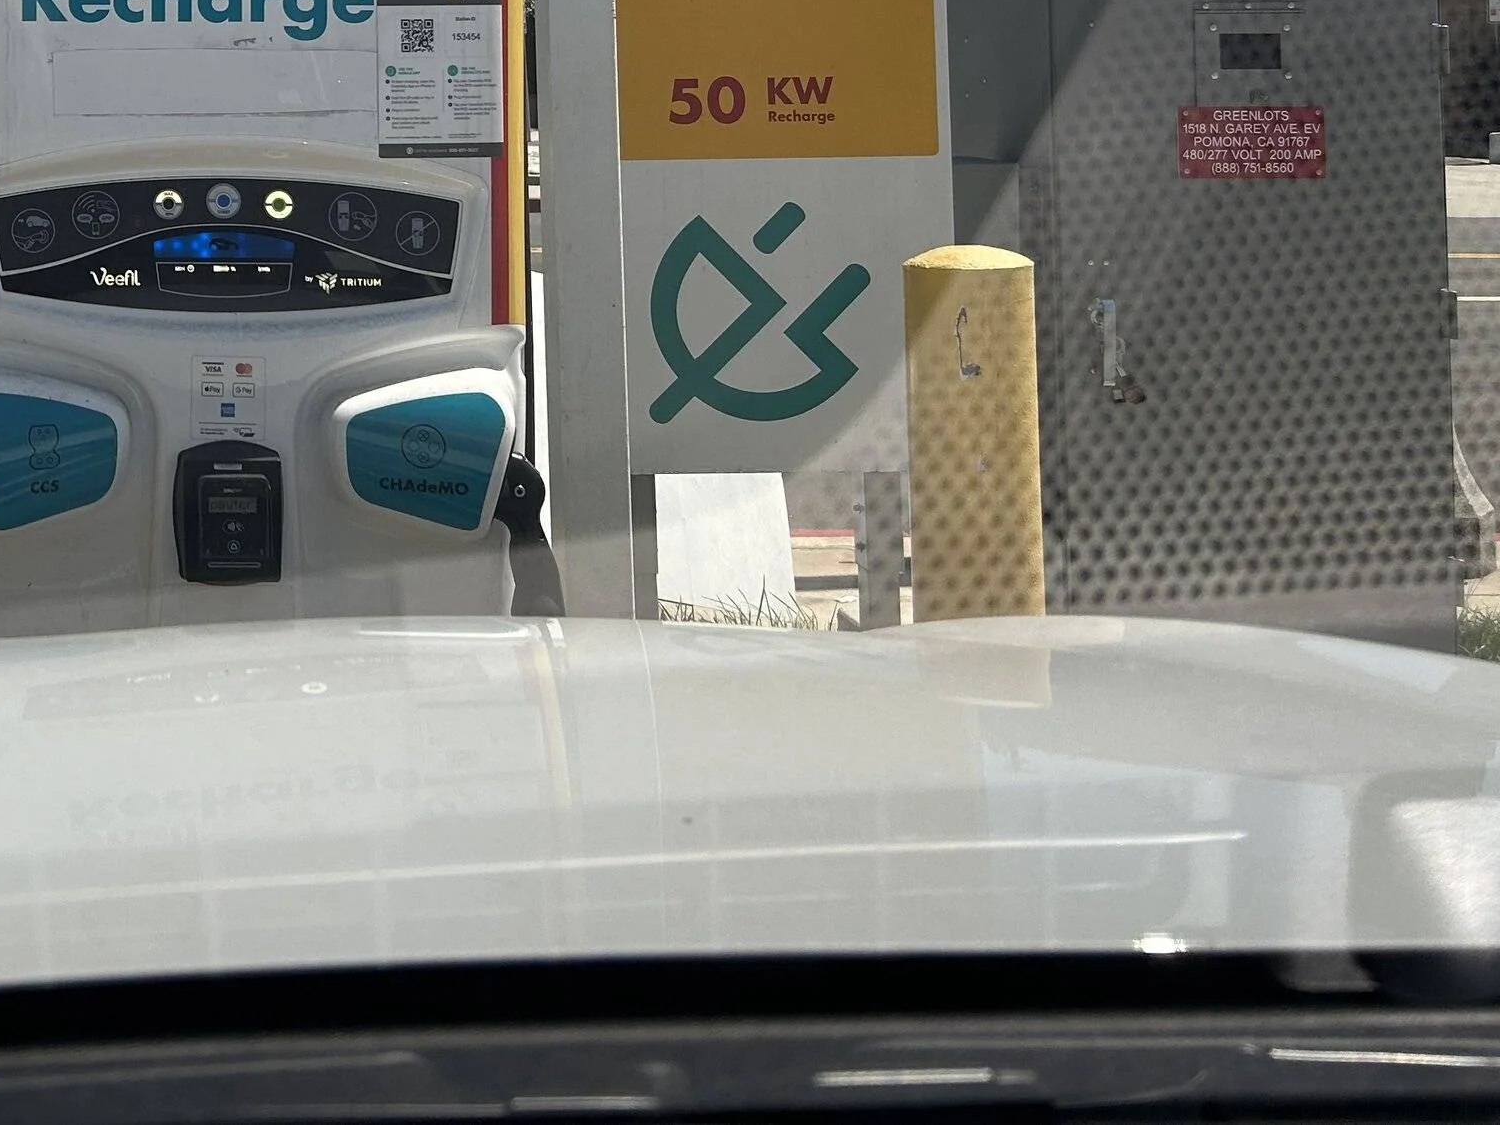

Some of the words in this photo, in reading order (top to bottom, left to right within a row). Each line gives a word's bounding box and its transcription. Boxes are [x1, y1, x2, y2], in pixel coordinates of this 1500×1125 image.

[452, 33, 481, 41] 153454
[669, 76, 746, 125] 50
[767, 76, 833, 105] KW
[768, 110, 836, 124] Recharge
[1213, 110, 1289, 121] GREENLOTS
[1183, 124, 1206, 134] 1518
[1210, 124, 1221, 134] N.
[1225, 124, 1270, 134] GAREY
[1304, 123, 1321, 133] EV
[1194, 137, 1253, 148] POMONA,
[1257, 137, 1275, 147] CA
[1278, 137, 1310, 147] 91767
[1183, 150, 1228, 160] 480/277
[1232, 150, 1263, 160] VOLT
[1270, 150, 1291, 160] 200
[1294, 150, 1322, 160] AMP
[1211, 162, 1240, 174] (888)
[1243, 163, 1294, 173] 751-8560
[90, 267, 141, 286] Veefil
[340, 278, 382, 287] TRITIUM
[30, 479, 59, 494] CCS
[379, 476, 469, 496] CHAdeMO
